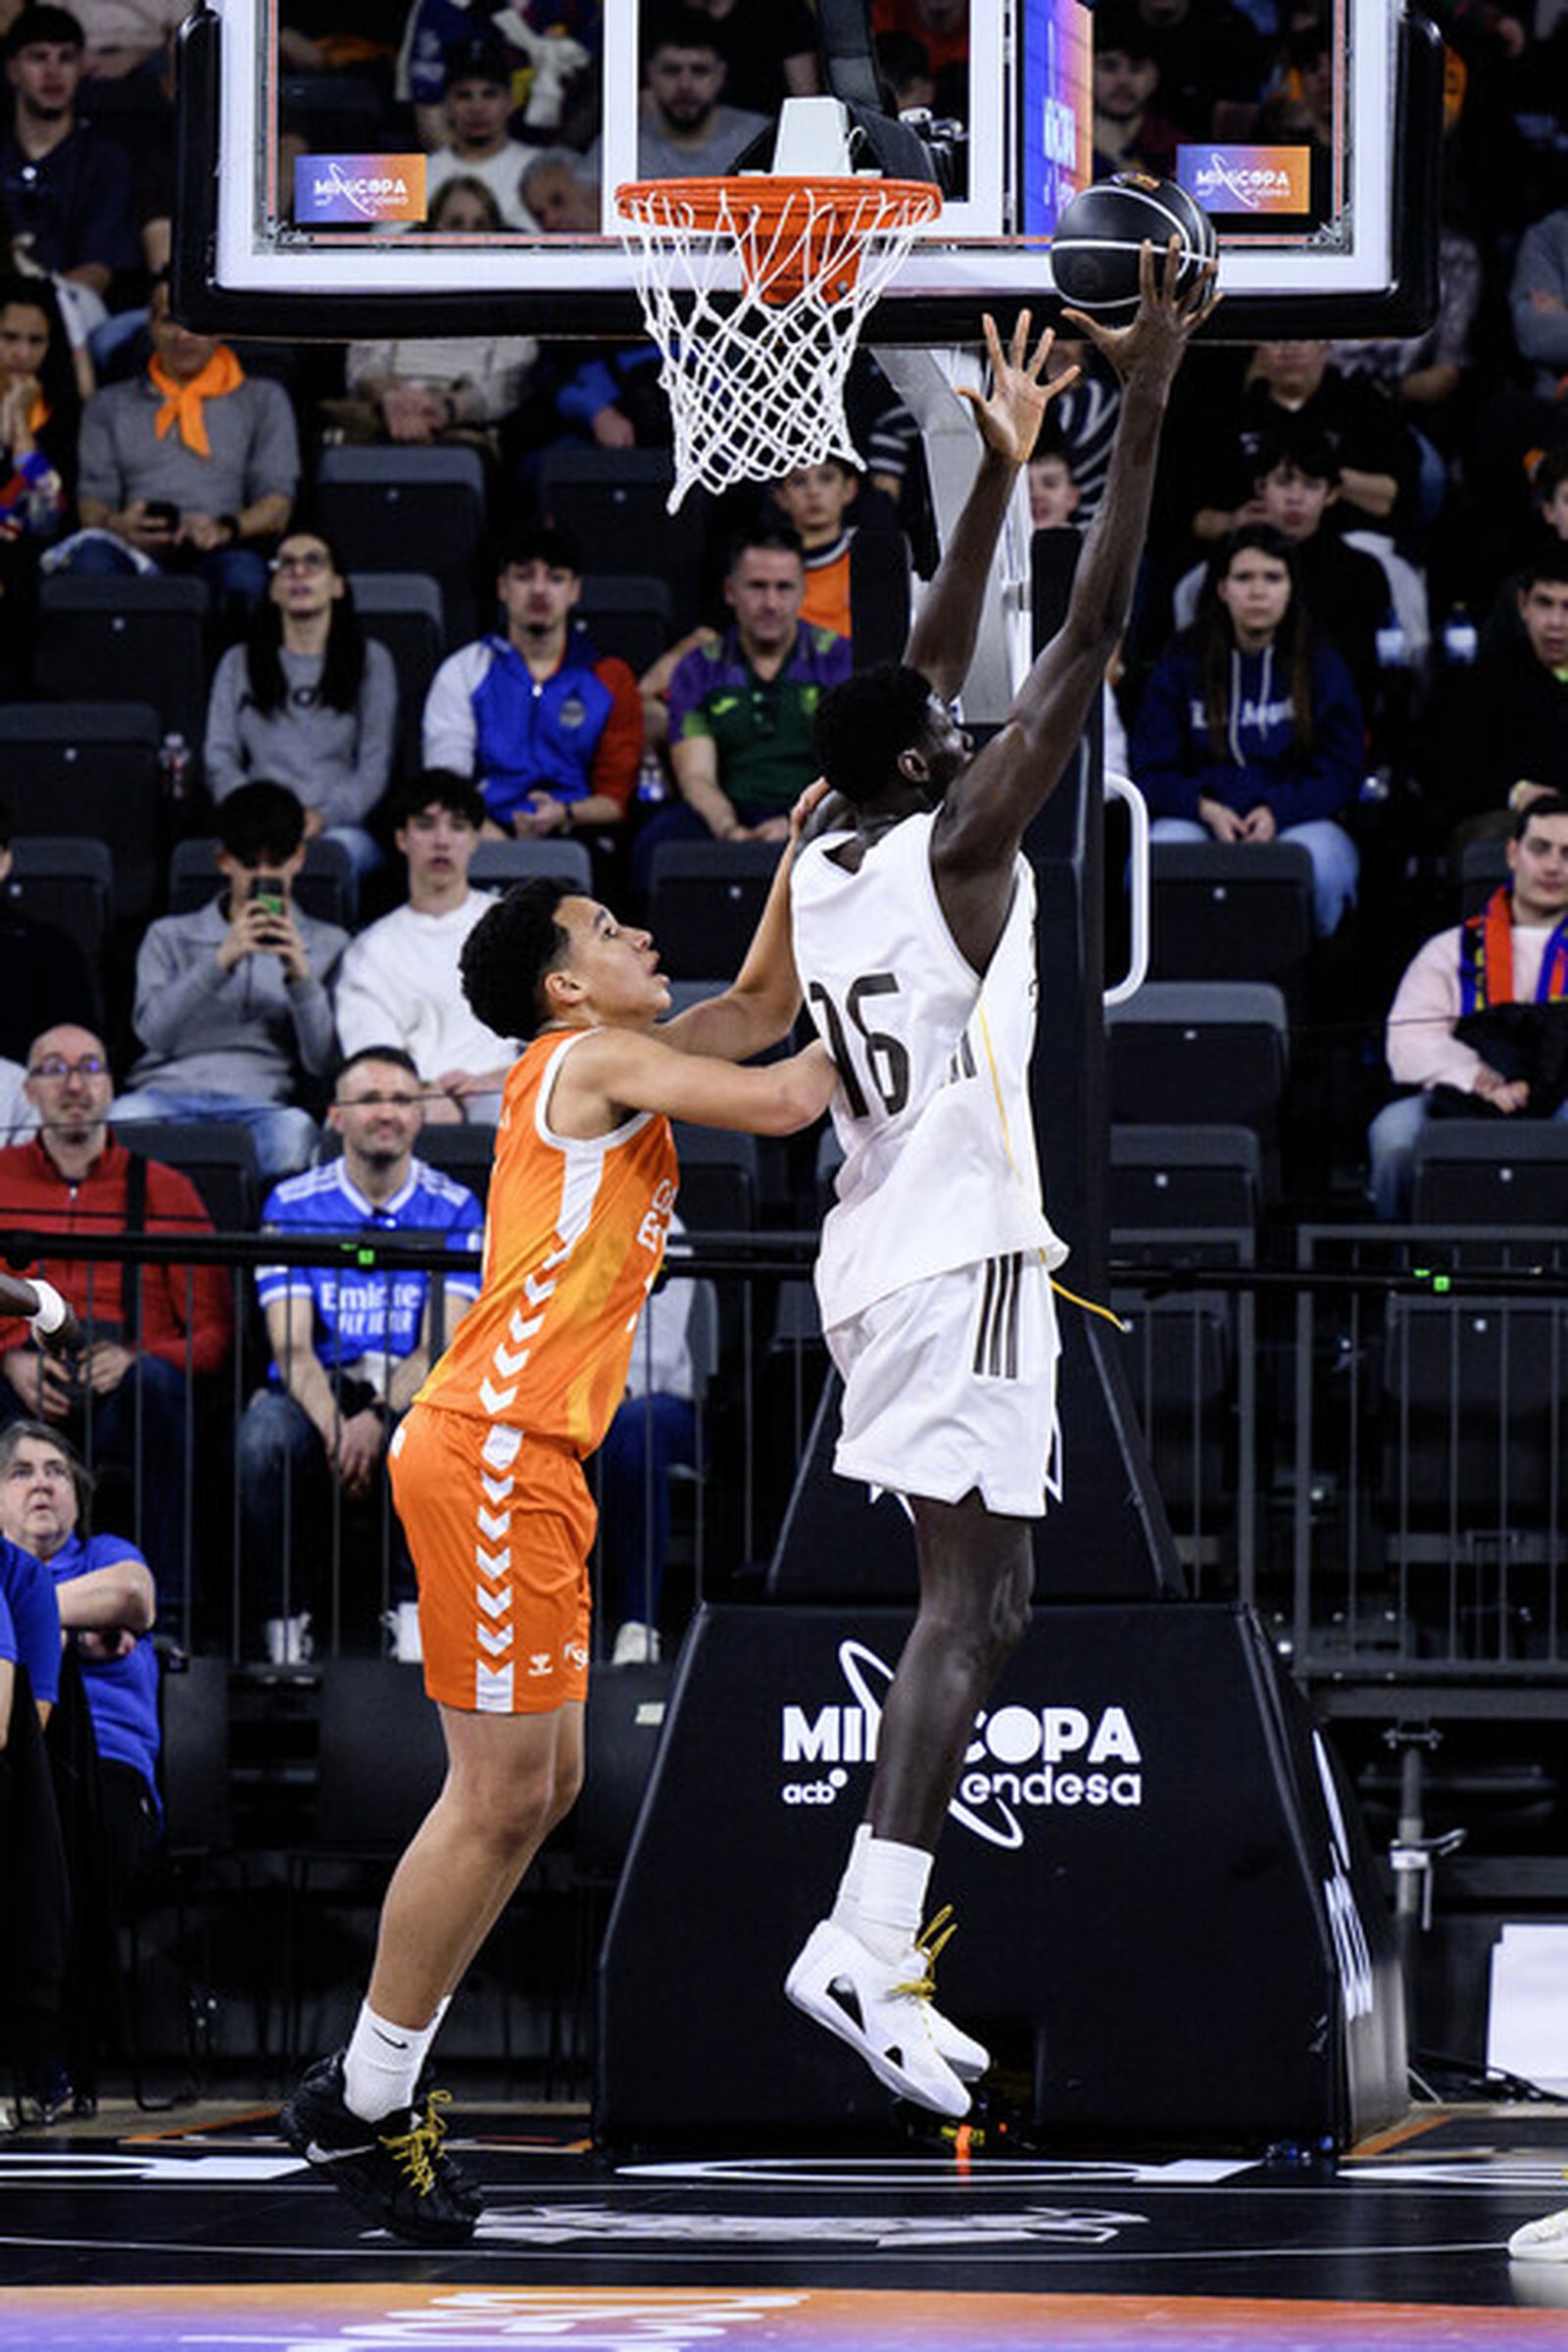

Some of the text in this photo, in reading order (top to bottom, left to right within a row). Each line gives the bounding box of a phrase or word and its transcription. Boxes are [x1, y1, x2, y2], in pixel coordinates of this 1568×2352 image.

[808, 973, 909, 1117] 16
[783, 1765, 1142, 1805] acb endesa
